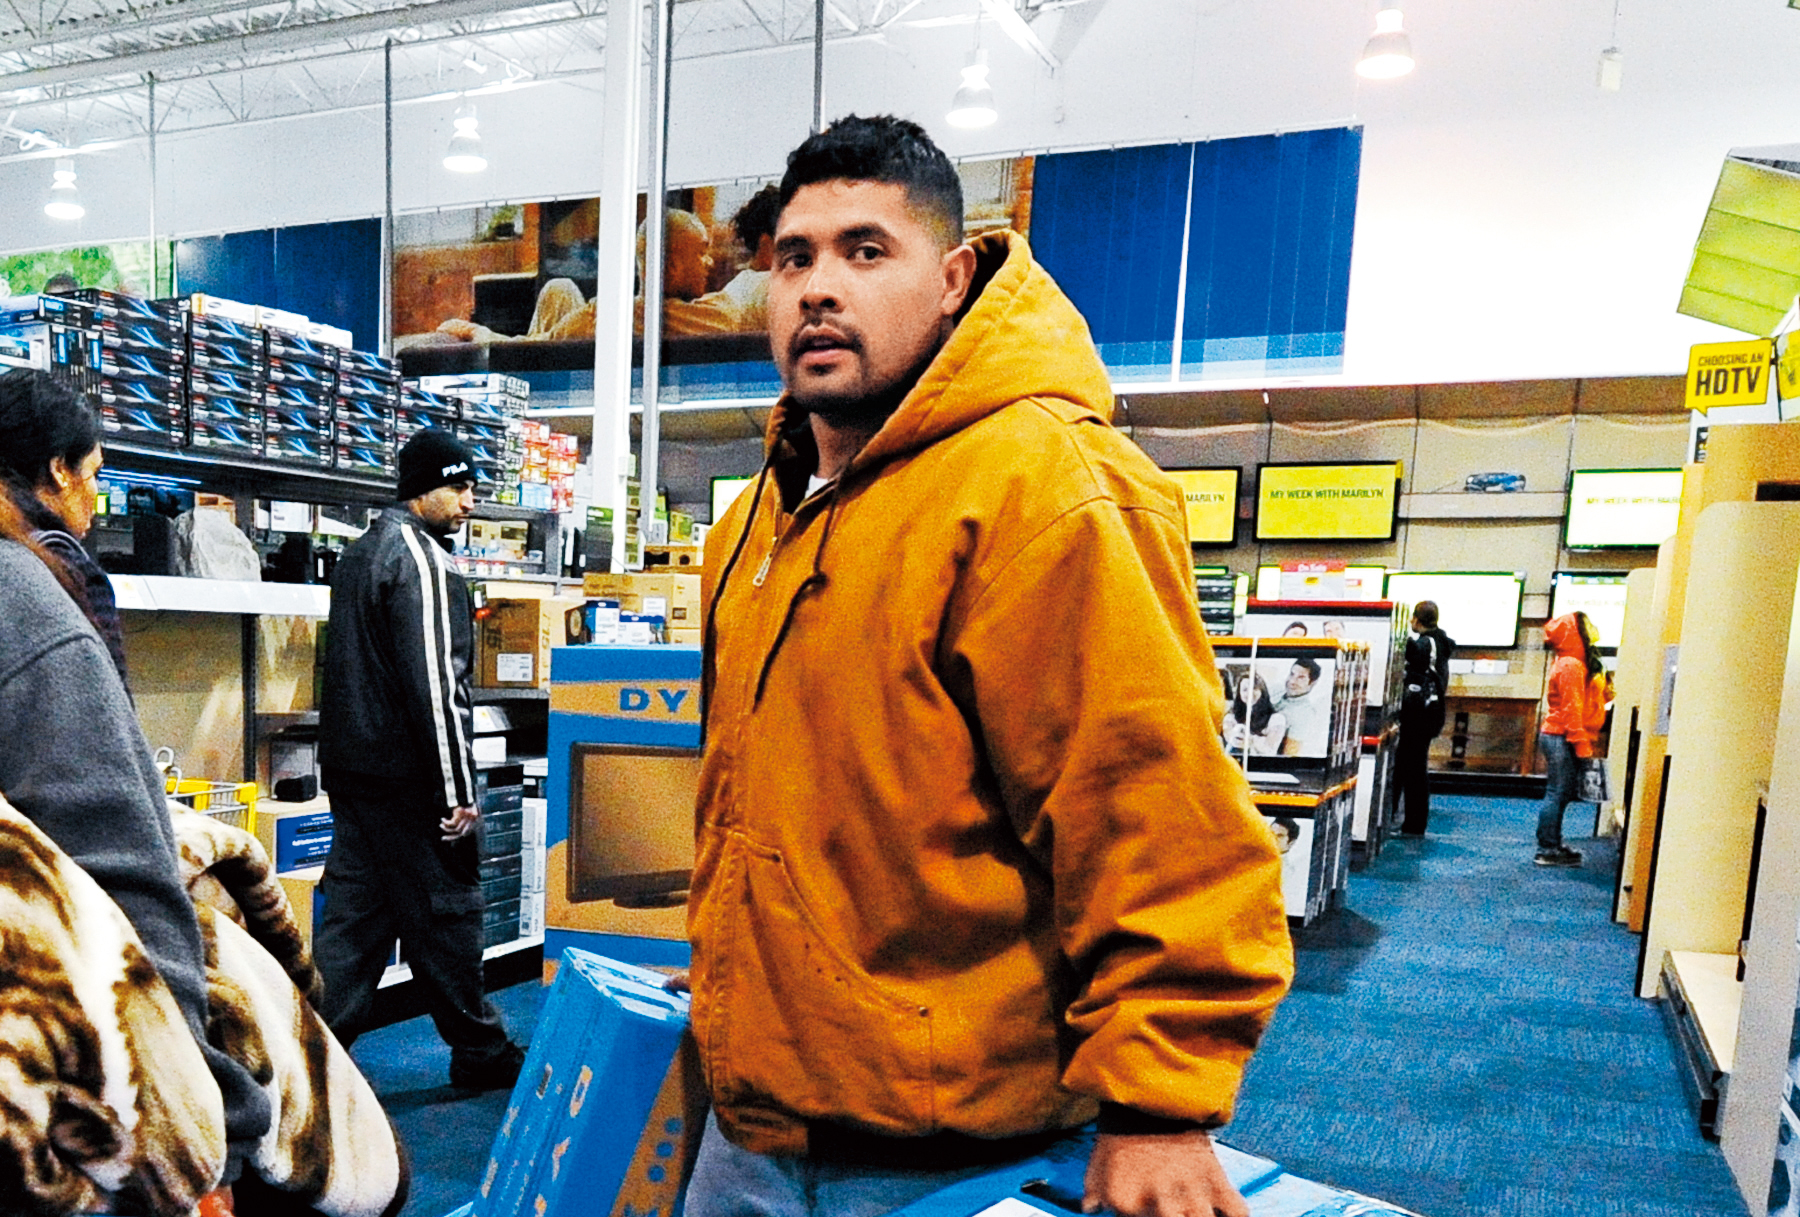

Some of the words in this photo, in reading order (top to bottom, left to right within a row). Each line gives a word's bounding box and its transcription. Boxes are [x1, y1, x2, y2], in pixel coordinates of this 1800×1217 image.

[1698, 353, 1748, 367] CHOOSING
[1750, 352, 1764, 364] AN
[1695, 366, 1762, 397] HDTV
[442, 461, 469, 477] FILA
[1185, 493, 1225, 503] MARILYN
[1270, 489, 1284, 498] MY
[1287, 489, 1313, 499] WEEK
[1315, 489, 1340, 498] WITH
[1341, 488, 1384, 498] MARILYN
[619, 687, 700, 713] DY
